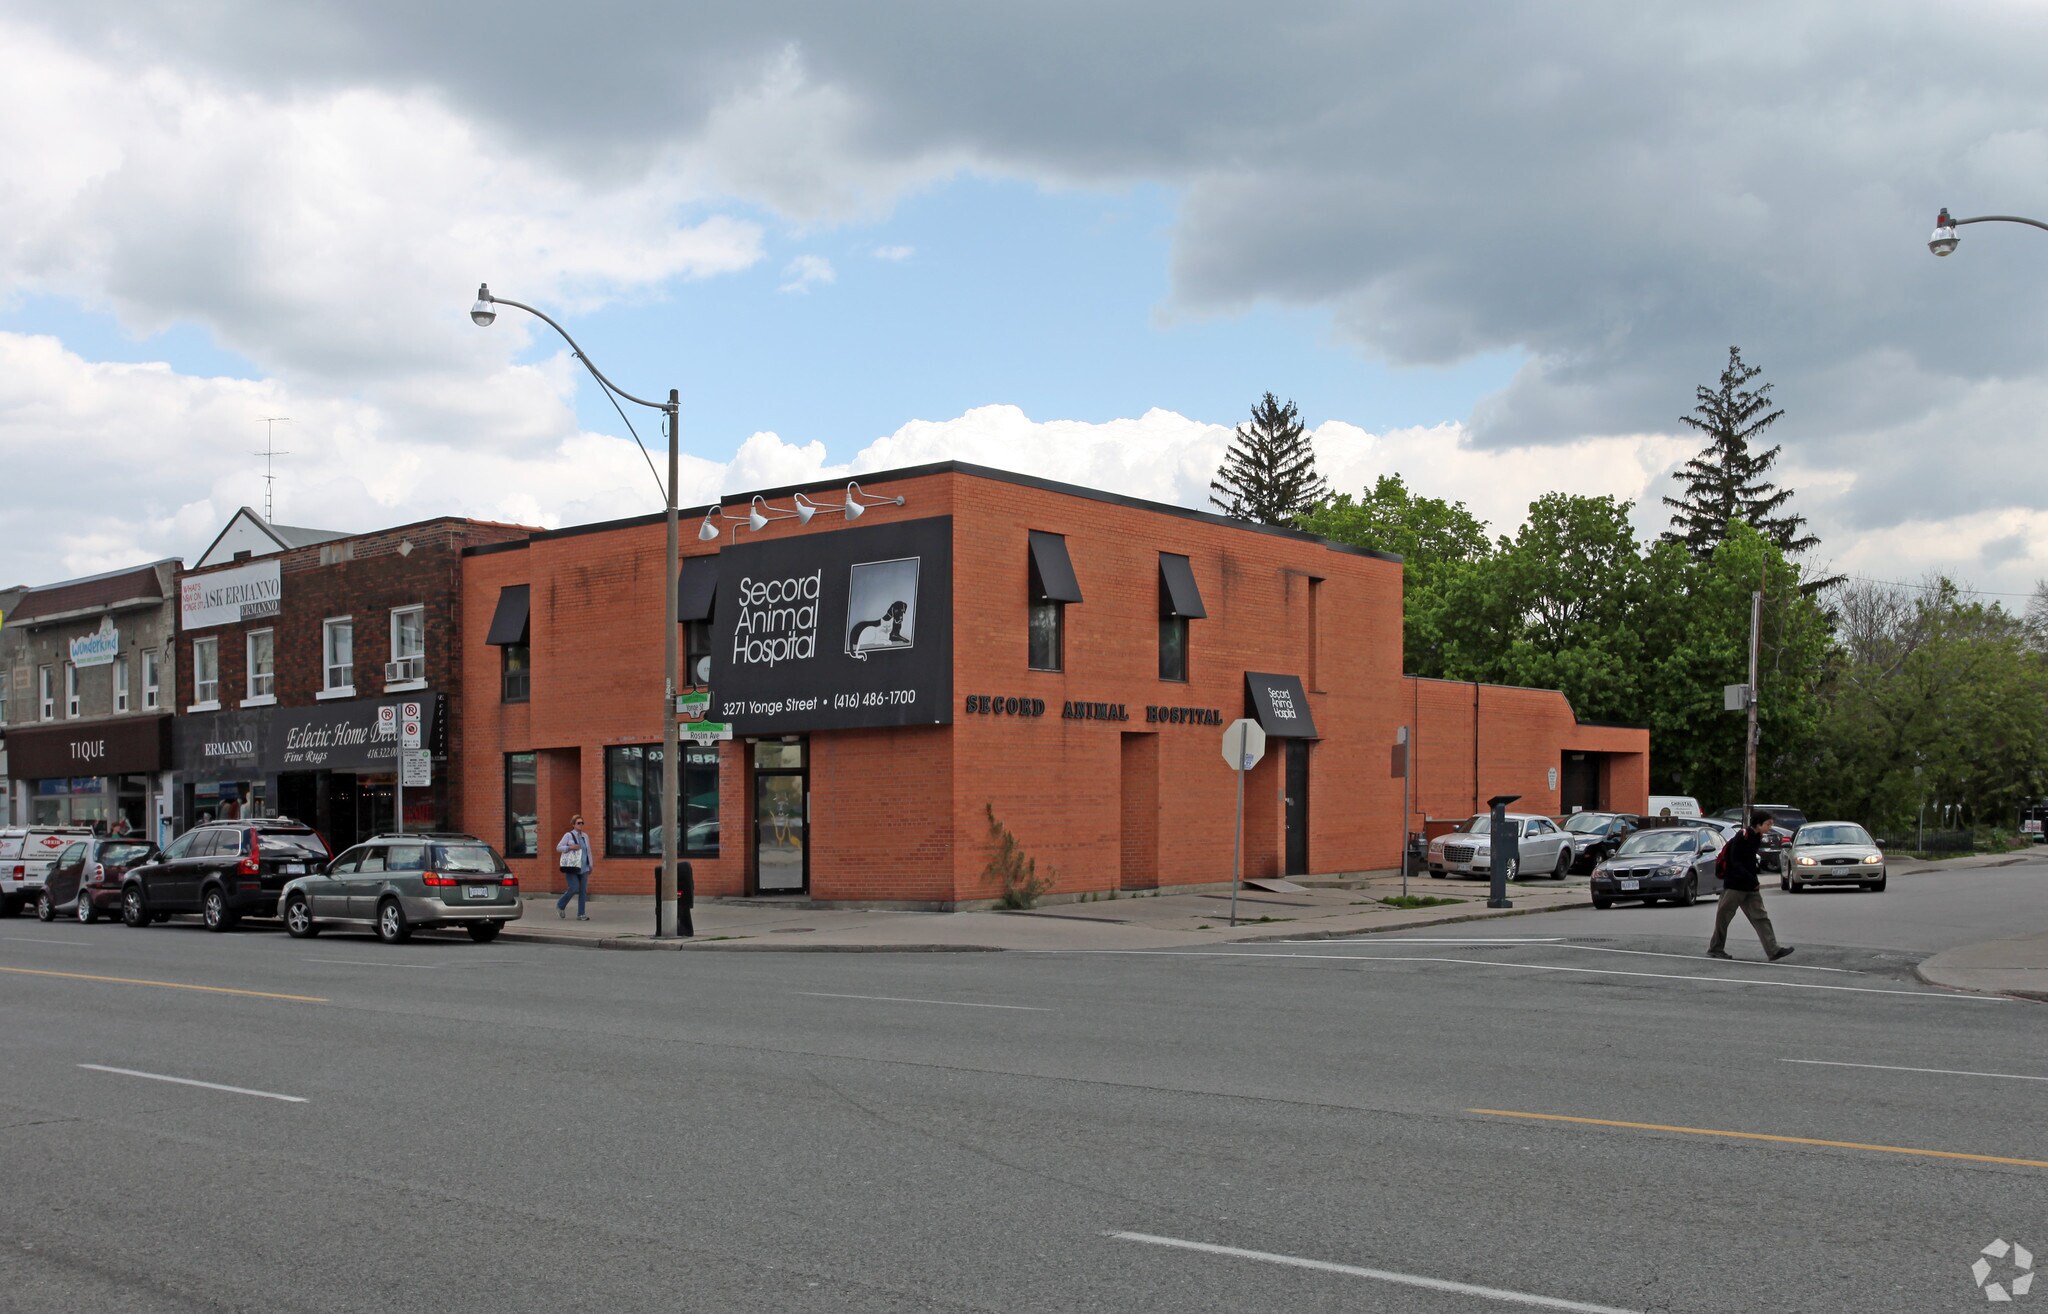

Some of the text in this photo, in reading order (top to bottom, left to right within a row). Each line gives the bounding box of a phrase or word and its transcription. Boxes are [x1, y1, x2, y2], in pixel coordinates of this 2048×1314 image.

[203, 578, 279, 609] ASK ERMANNO
[739, 568, 822, 607] Secord
[240, 600, 278, 616] ERMANNO
[735, 599, 819, 635] Animal
[732, 628, 817, 668] Hospital
[722, 689, 916, 716] 3271 Yonge Street (416) 486-1700
[1267, 687, 1290, 699] Secord
[1272, 697, 1294, 709] Animal
[686, 703, 699, 712] Yonge
[966, 694, 1223, 726] SECORD ANIMAL HOSPITAL
[1273, 707, 1297, 720] Hospital
[286, 722, 332, 750] Eclectic
[331, 720, 369, 747] Home
[70, 740, 105, 762] TIQUE
[205, 740, 252, 756] ERMANNO
[284, 751, 304, 763] Fine
[305, 750, 328, 764] Rugs
